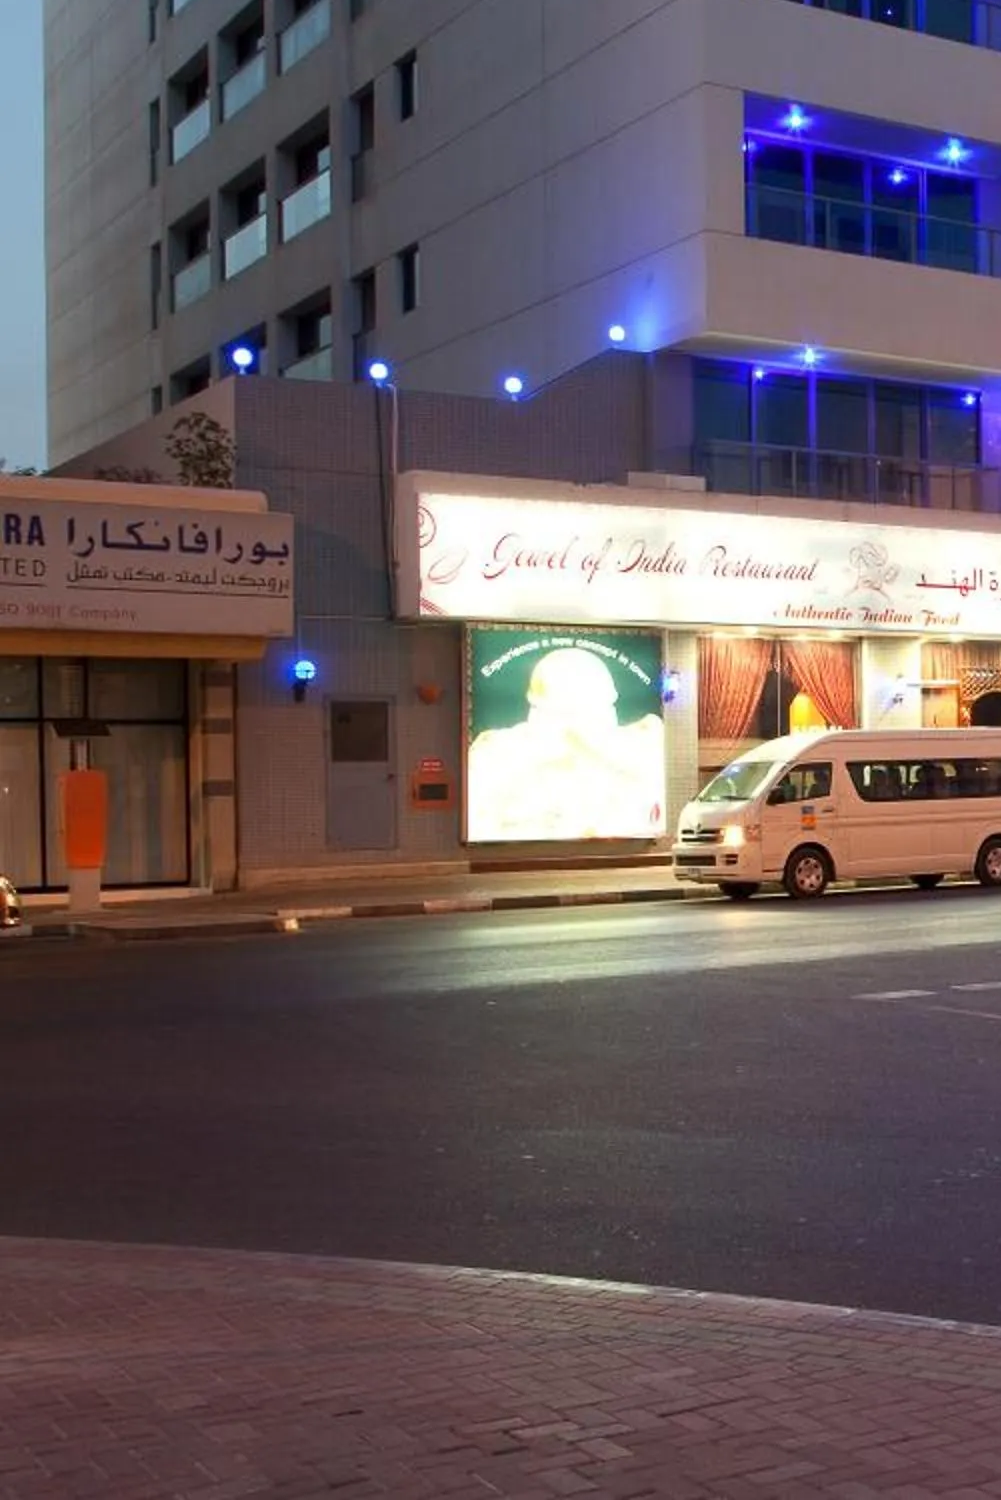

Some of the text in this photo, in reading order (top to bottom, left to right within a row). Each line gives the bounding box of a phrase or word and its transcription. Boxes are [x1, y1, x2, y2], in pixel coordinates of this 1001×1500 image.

[0, 557, 47, 578] TED
[582, 537, 612, 584] of
[617, 538, 688, 576] India
[699, 544, 821, 582] Restaurant
[915, 567, 984, 598] الهند
[69, 604, 138, 622] Company
[773, 603, 853, 622] Authentic
[859, 606, 913, 624] Indian
[629, 661, 652, 686] town
